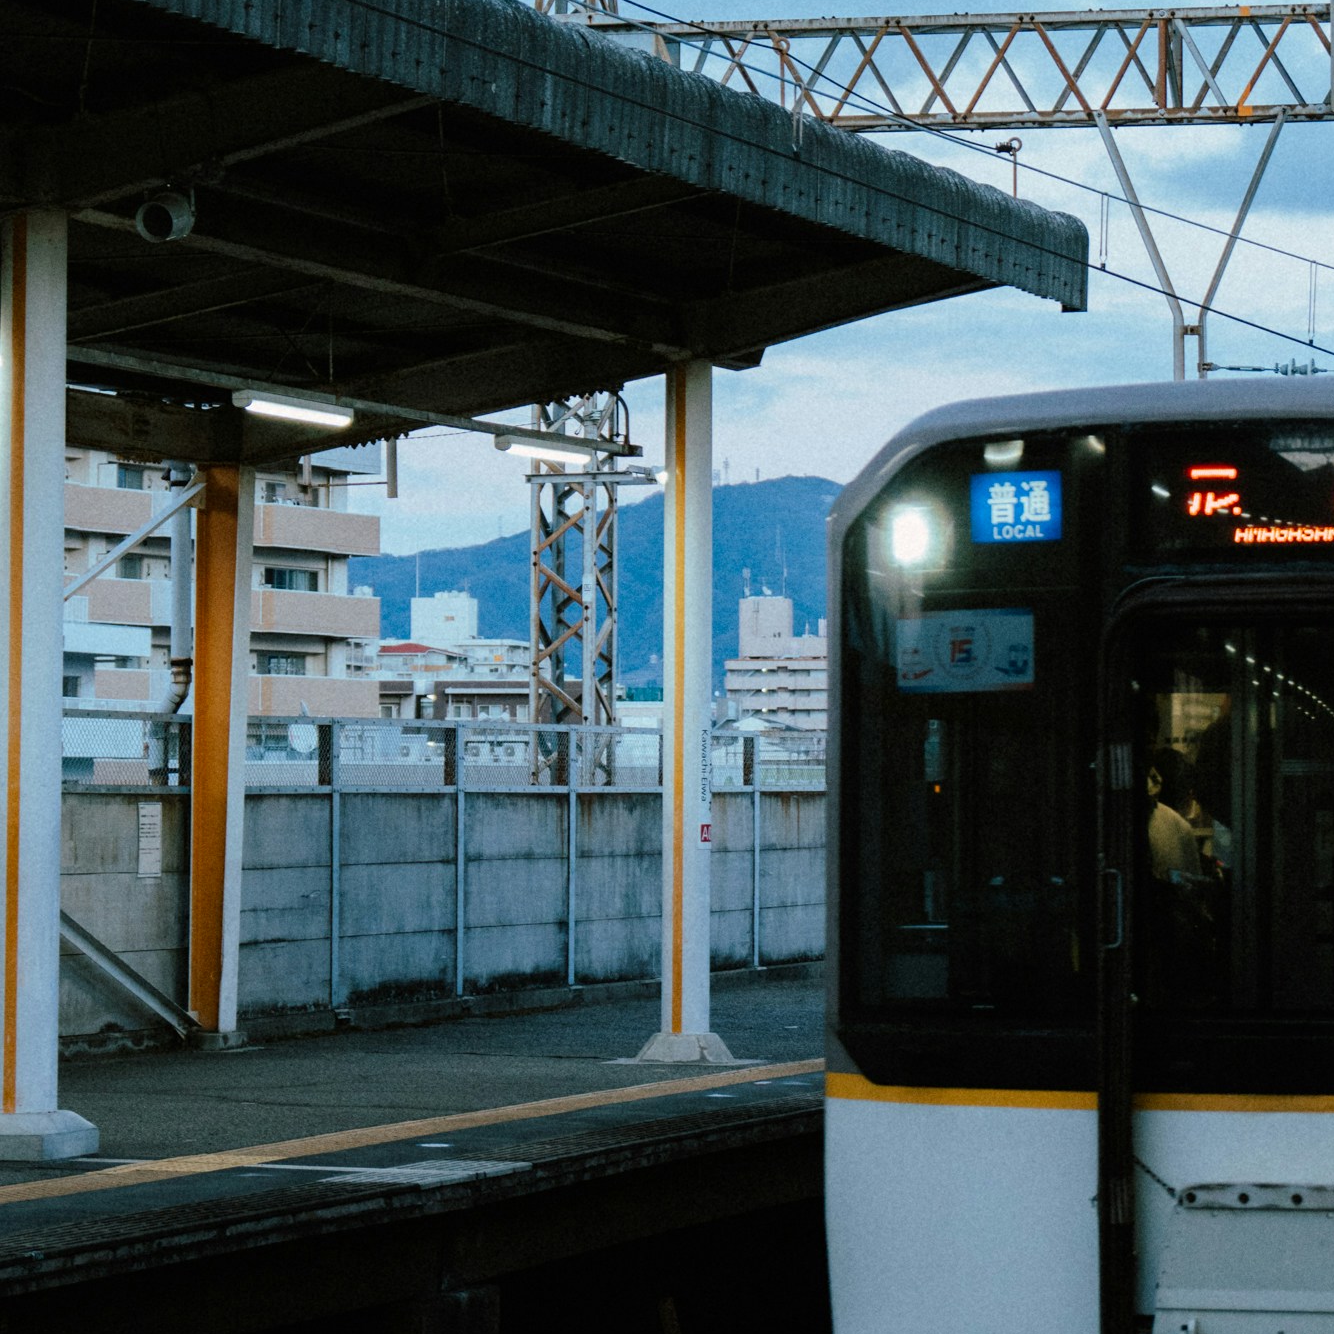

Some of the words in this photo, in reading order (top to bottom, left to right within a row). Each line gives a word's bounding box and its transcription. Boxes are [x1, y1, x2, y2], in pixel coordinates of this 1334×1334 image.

[987, 480, 1051, 525] 普通
[992, 525, 1044, 540] LOCAL
[701, 729, 709, 802] Kawachi-Eiwa
